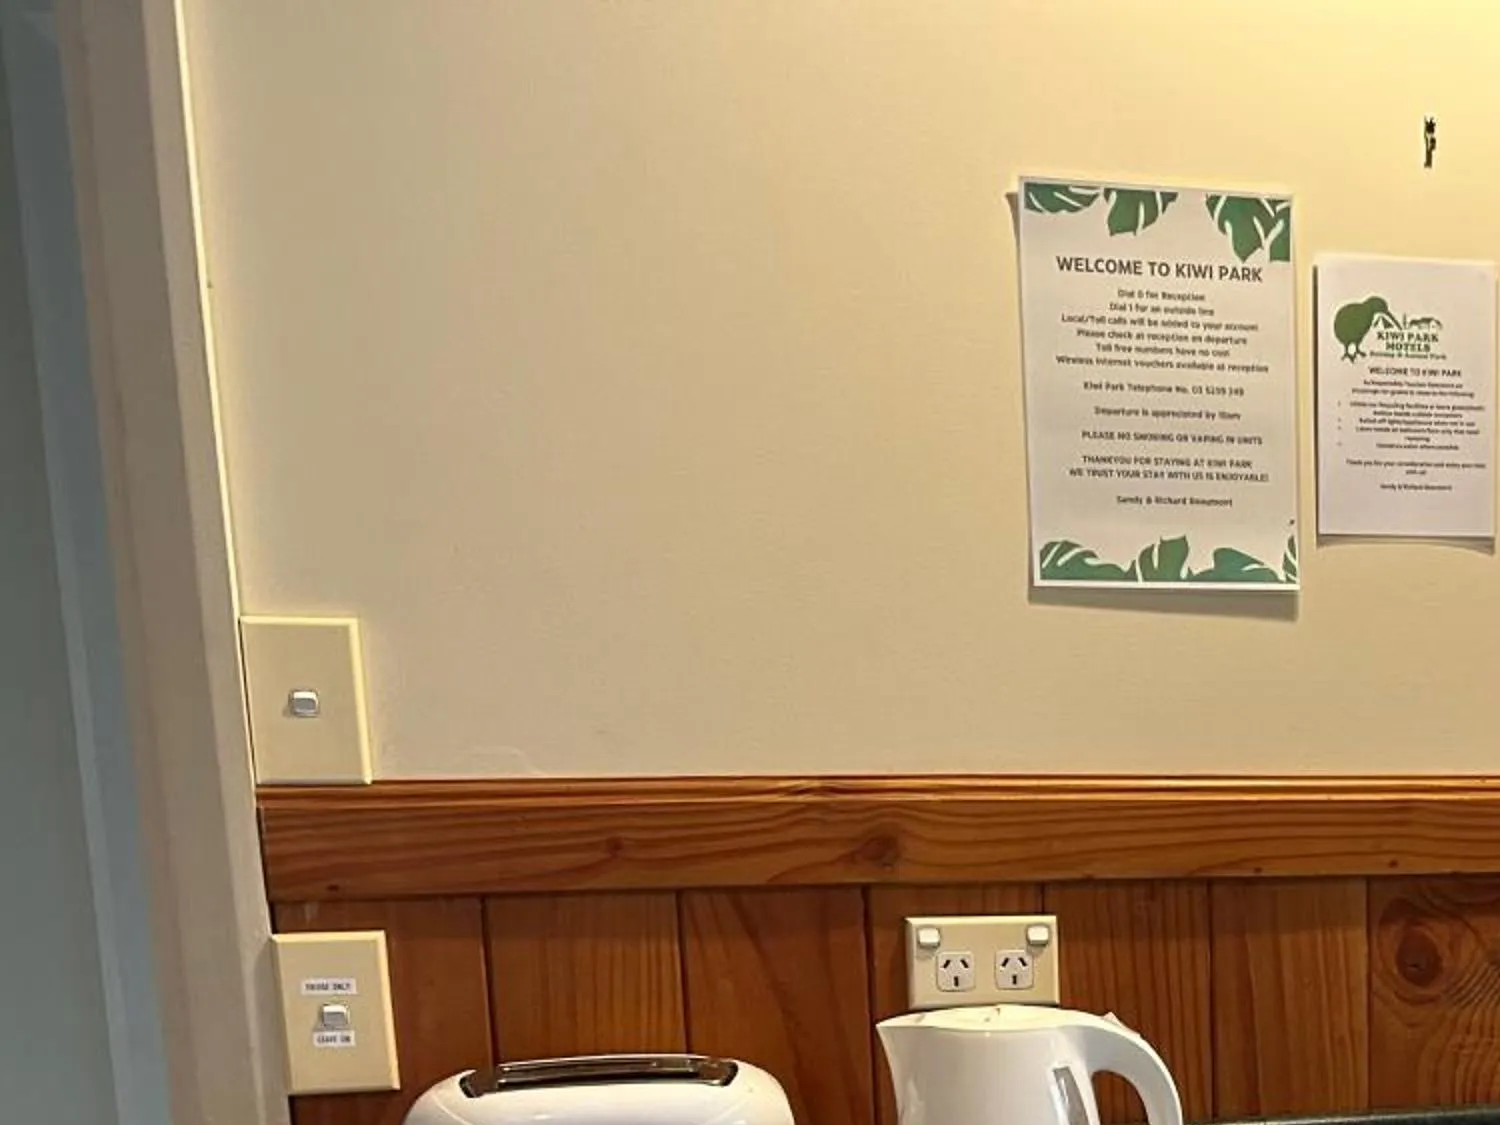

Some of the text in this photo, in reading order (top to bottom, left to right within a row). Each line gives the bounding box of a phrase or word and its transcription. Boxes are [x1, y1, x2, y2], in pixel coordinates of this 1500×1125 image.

[1055, 255, 1264, 284] WELCOME TO KIWI PARK
[1161, 291, 1205, 302] Reception
[1109, 301, 1126, 311] Dial
[1135, 302, 1149, 313] for
[1163, 305, 1197, 315] outside
[1061, 312, 1107, 324] Local/Toll
[1107, 315, 1127, 325] calls
[1129, 317, 1145, 326] will
[1147, 317, 1158, 327] be
[1160, 318, 1189, 329] added
[1201, 322, 1223, 332] your
[1077, 327, 1105, 338] Please
[1107, 330, 1132, 340] check
[1135, 332, 1145, 340] at
[1146, 332, 1189, 343] reception
[1204, 334, 1247, 346] departure
[1375, 330, 1440, 343] KIWI PARK
[1113, 342, 1133, 353] free
[1133, 345, 1173, 355] numbers
[1175, 345, 1196, 356] have
[1198, 348, 1210, 357] no
[1385, 341, 1431, 353] MOTELS
[1055, 354, 1094, 365] Wireless
[1133, 358, 1174, 369] vouchers
[1176, 360, 1215, 371] available
[1216, 362, 1225, 371] at
[1226, 362, 1269, 374] reception
[1367, 366, 1463, 378] WELCOME TO KIWI PARK
[1083, 380, 1103, 391] Kiwi
[1105, 381, 1125, 392] Park
[1127, 382, 1173, 394] Telephone
[1093, 404, 1140, 417] Departure
[1141, 406, 1149, 416] is
[1151, 408, 1203, 419] appreciated
[1205, 410, 1217, 421] by
[1081, 429, 1263, 446] PLEASE NO SMOKING OR VAPING IN UNITS
[1082, 454, 1253, 470] THANKYOU FOR STAYING AT KIWI PARK
[1069, 466, 1084, 478] WE
[1086, 467, 1115, 479] TRUST
[1116, 468, 1142, 480] YOUR
[1143, 469, 1166, 480] STAY
[1167, 470, 1190, 481] WITH
[1192, 470, 1204, 482] US
[1205, 471, 1215, 482] IS
[1116, 495, 1143, 506] Sandy
[1154, 495, 1187, 506] Richard
[332, 983, 351, 991] ONLY
